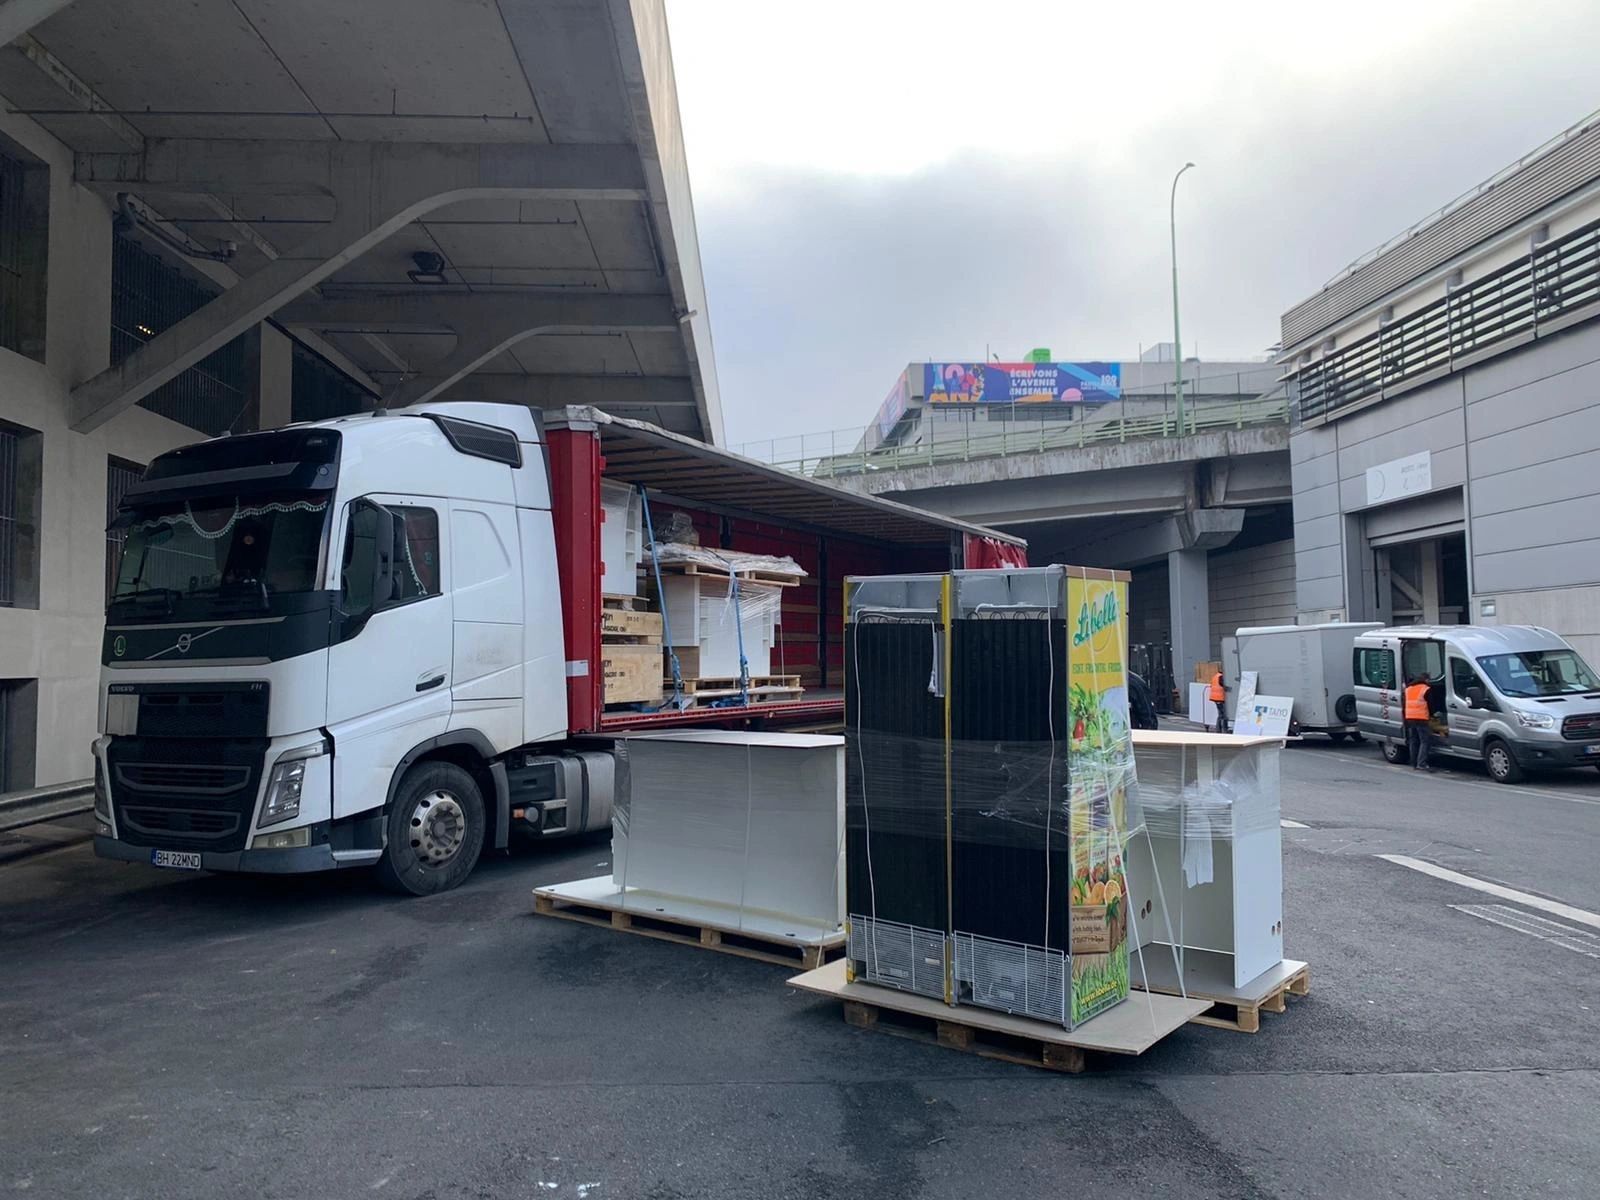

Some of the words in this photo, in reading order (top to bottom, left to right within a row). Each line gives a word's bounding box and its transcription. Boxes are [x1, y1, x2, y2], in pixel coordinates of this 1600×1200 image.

[1010, 368, 1058, 378] ÉCRIVONS
[1012, 378, 1056, 387] L'AVENIR
[1009, 387, 1058, 395] ENSEMBLE
[157, 852, 169, 864] BH
